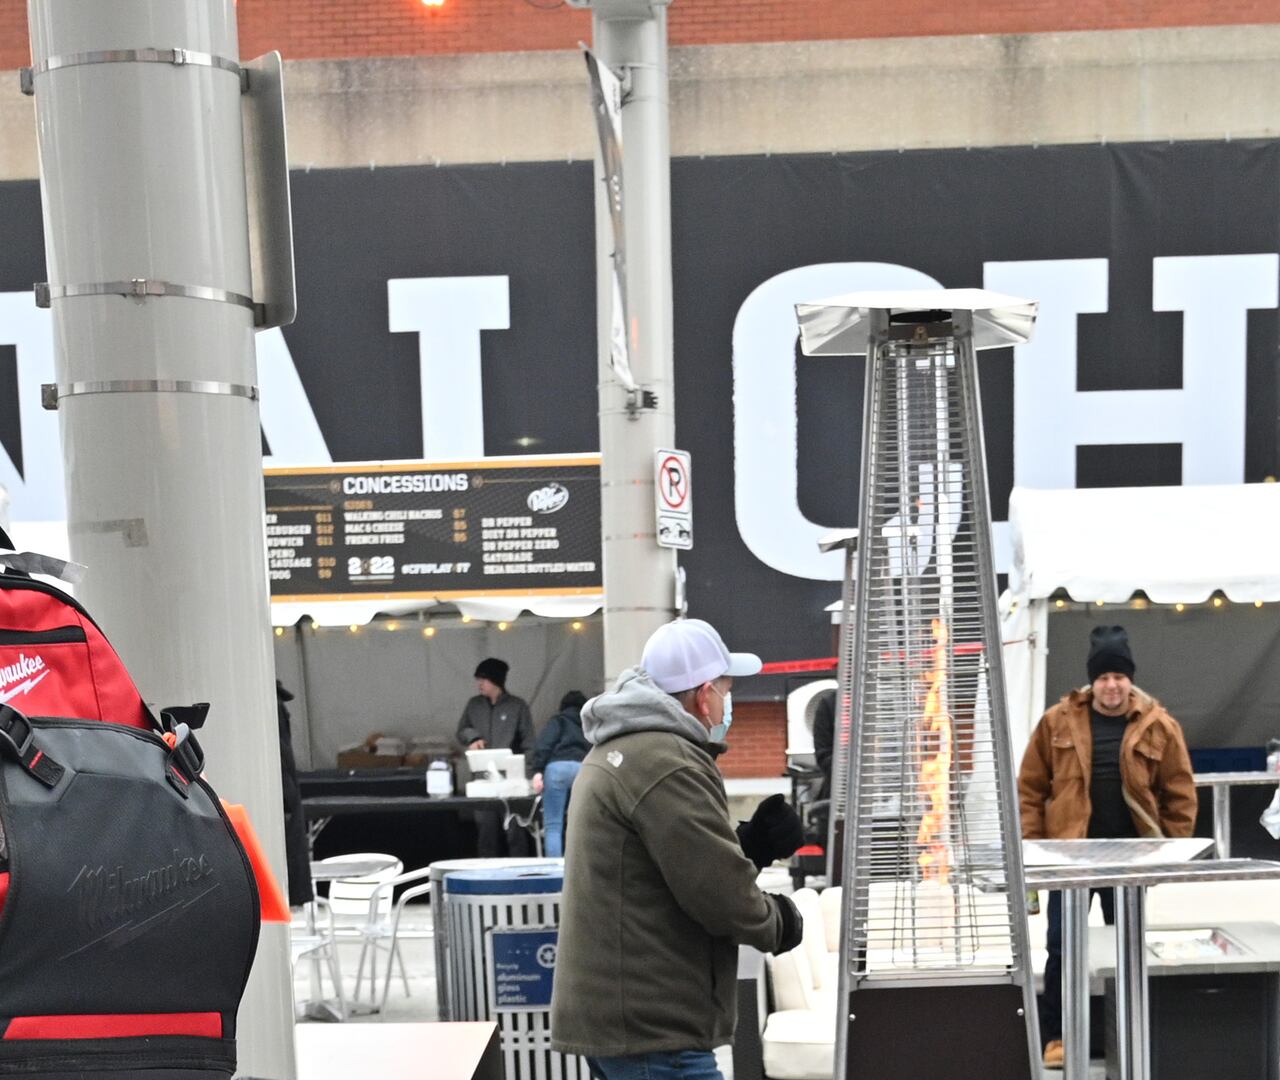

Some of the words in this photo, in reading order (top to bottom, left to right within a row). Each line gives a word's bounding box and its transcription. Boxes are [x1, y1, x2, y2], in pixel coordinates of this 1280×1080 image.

[343, 473, 468, 495] CONCESSIONS
[496, 516, 533, 527] PEPPER
[372, 522, 405, 533] CHEESE
[520, 527, 557, 538] PEPPER
[345, 534, 379, 545] FRENCH
[380, 533, 405, 544] FRIES
[497, 540, 533, 551] PEPPER
[482, 552, 533, 563] GATORADE
